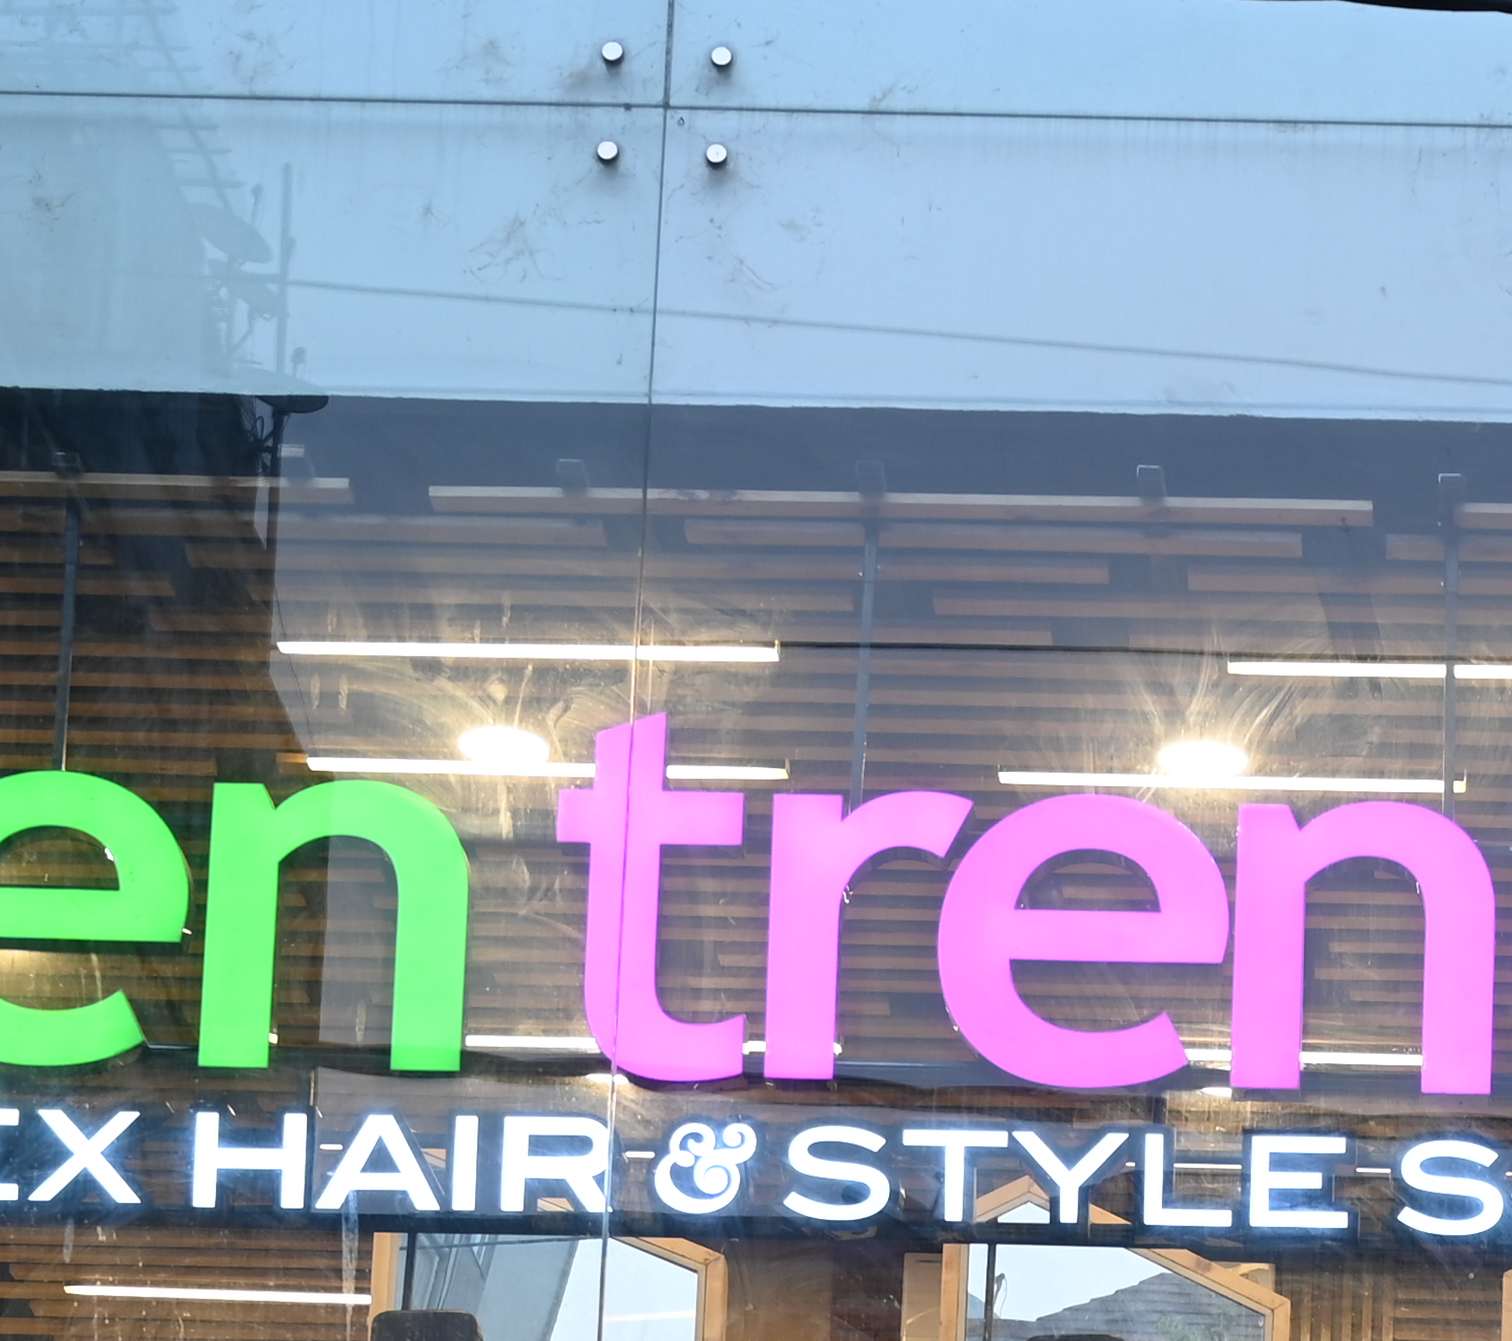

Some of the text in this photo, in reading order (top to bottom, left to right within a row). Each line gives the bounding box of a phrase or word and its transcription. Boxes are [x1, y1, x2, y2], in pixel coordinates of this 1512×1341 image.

[191, 1110, 613, 1213] HAIR
[653, 1121, 757, 1215] &
[783, 1125, 1349, 1230] STYLE
